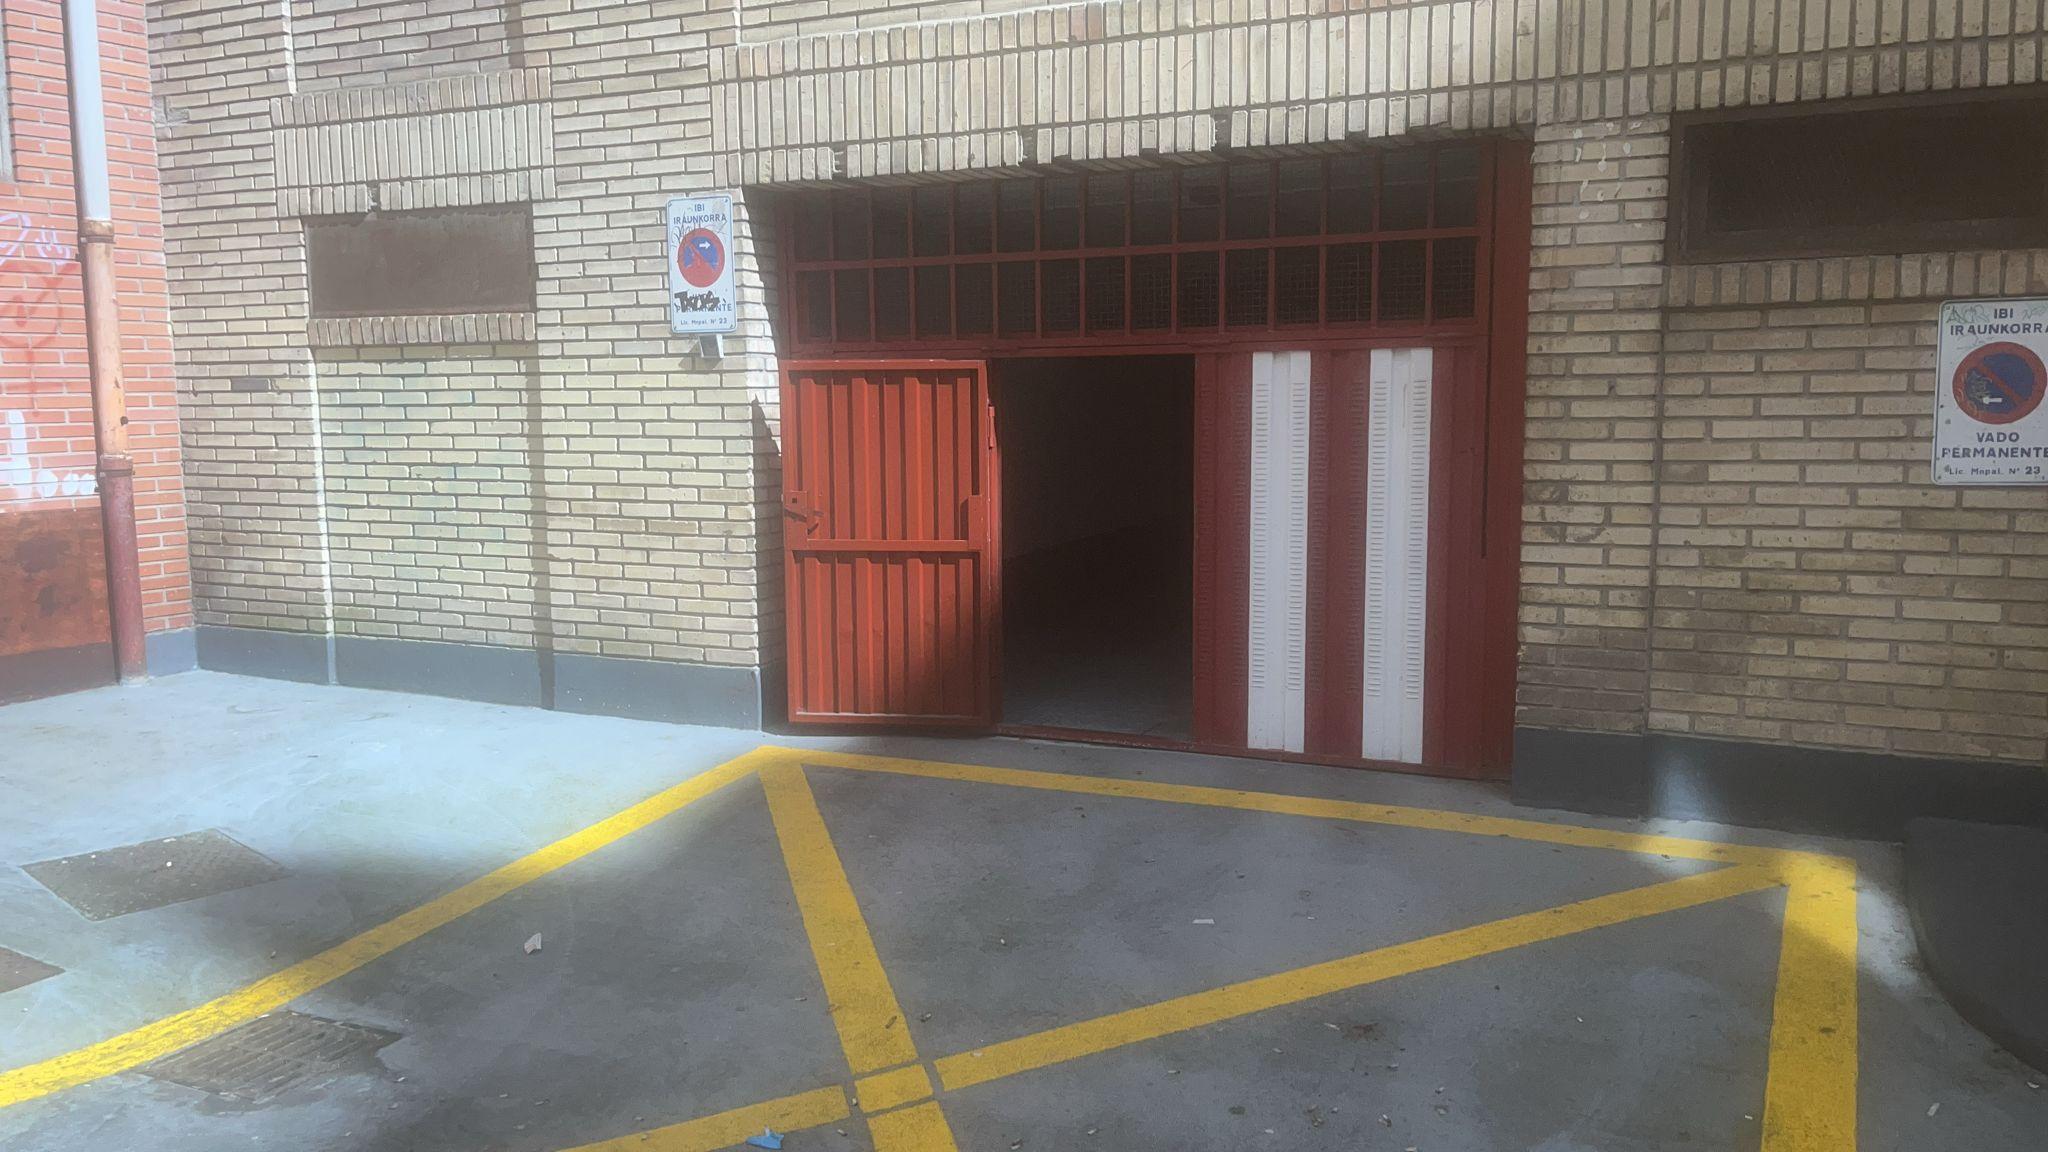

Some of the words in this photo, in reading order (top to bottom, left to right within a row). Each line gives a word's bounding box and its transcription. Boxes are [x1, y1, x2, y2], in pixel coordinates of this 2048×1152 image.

[694, 203, 705, 212] IBI
[673, 213, 727, 225] IRAUNKORRA
[1994, 308, 2014, 319] IBI
[1976, 431, 2020, 443] VADO
[2025, 465, 2041, 475] 23
